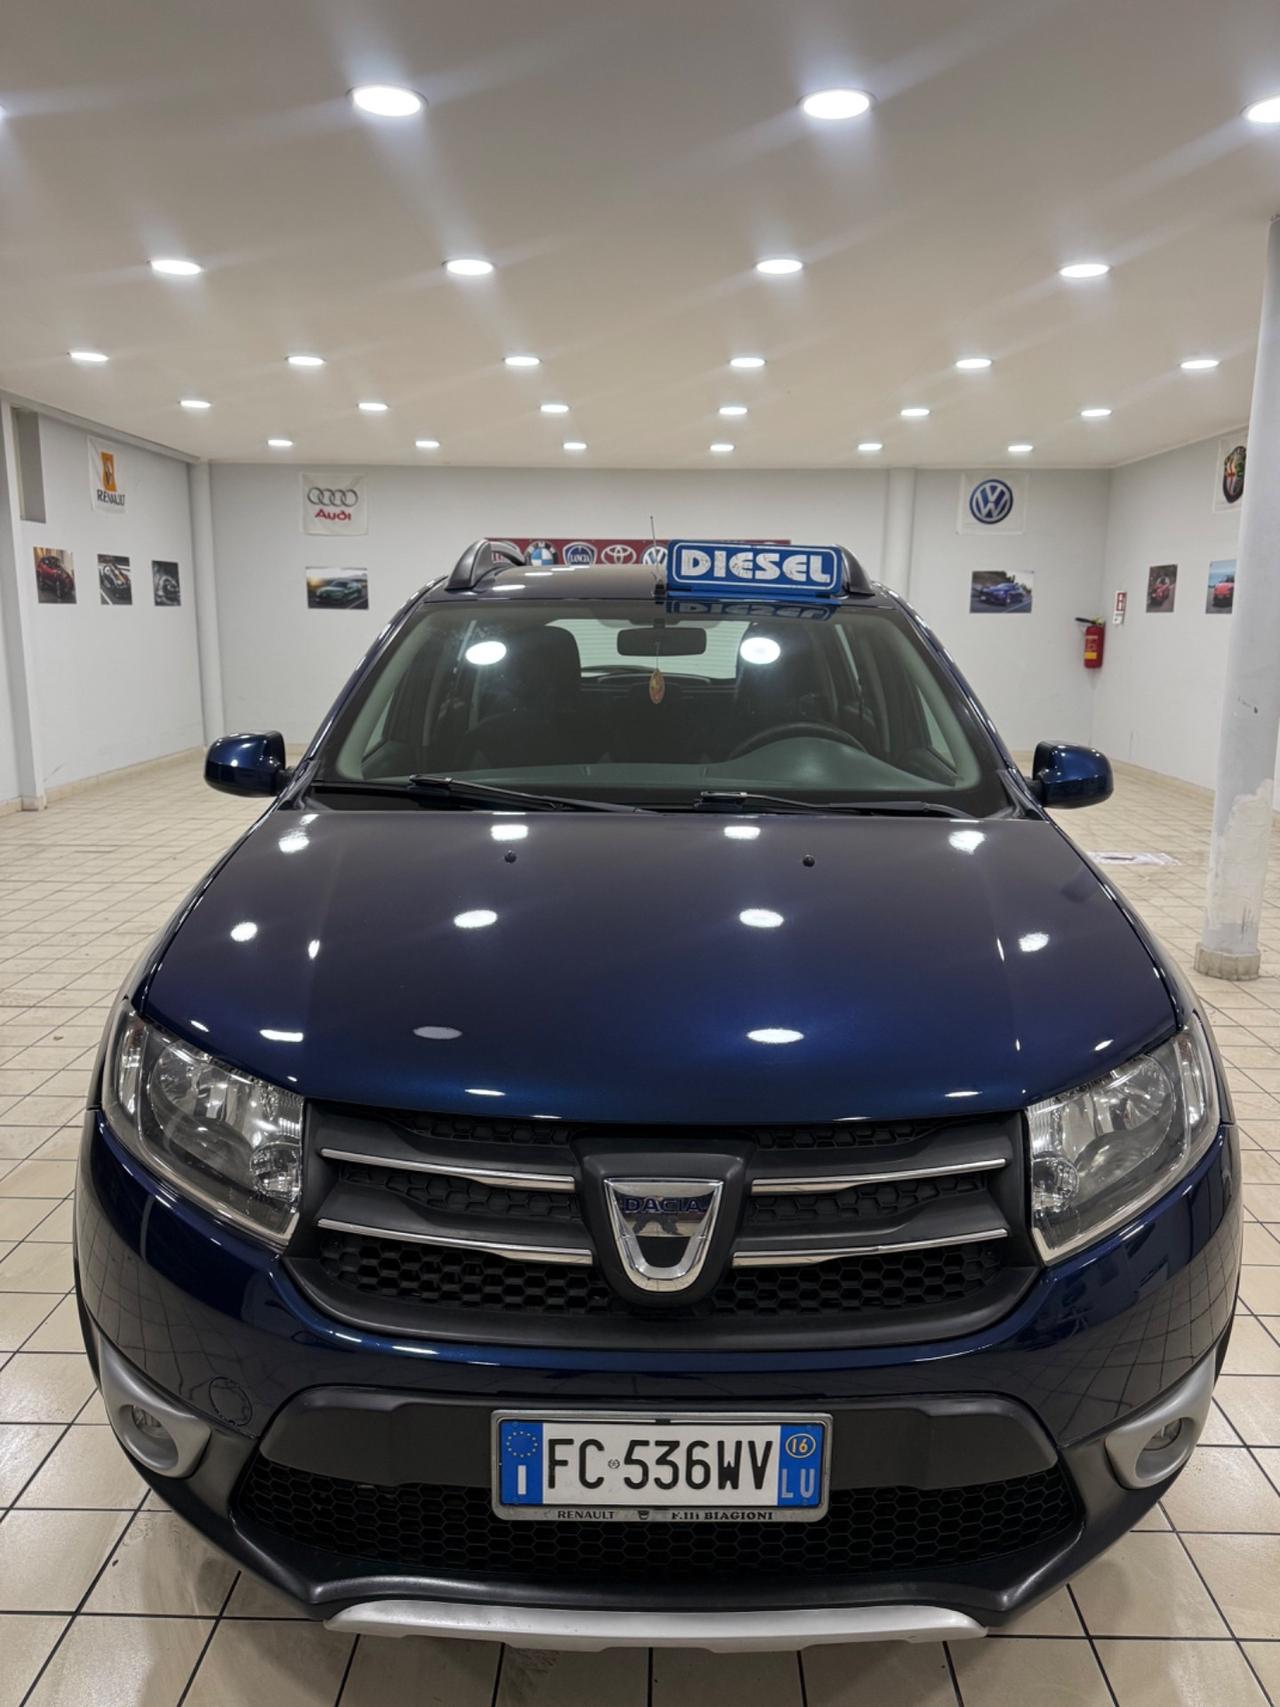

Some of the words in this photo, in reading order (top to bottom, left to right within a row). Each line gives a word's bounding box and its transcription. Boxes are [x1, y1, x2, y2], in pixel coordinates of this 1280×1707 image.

[315, 509, 352, 521] Audi
[681, 549, 831, 583] DIESEL
[624, 1198, 701, 1212] DACIA
[791, 1438, 808, 1453] 16
[781, 1468, 815, 1498] LU
[557, 1510, 616, 1520] RENAULT
[703, 1511, 774, 1520] BIAGIONI
